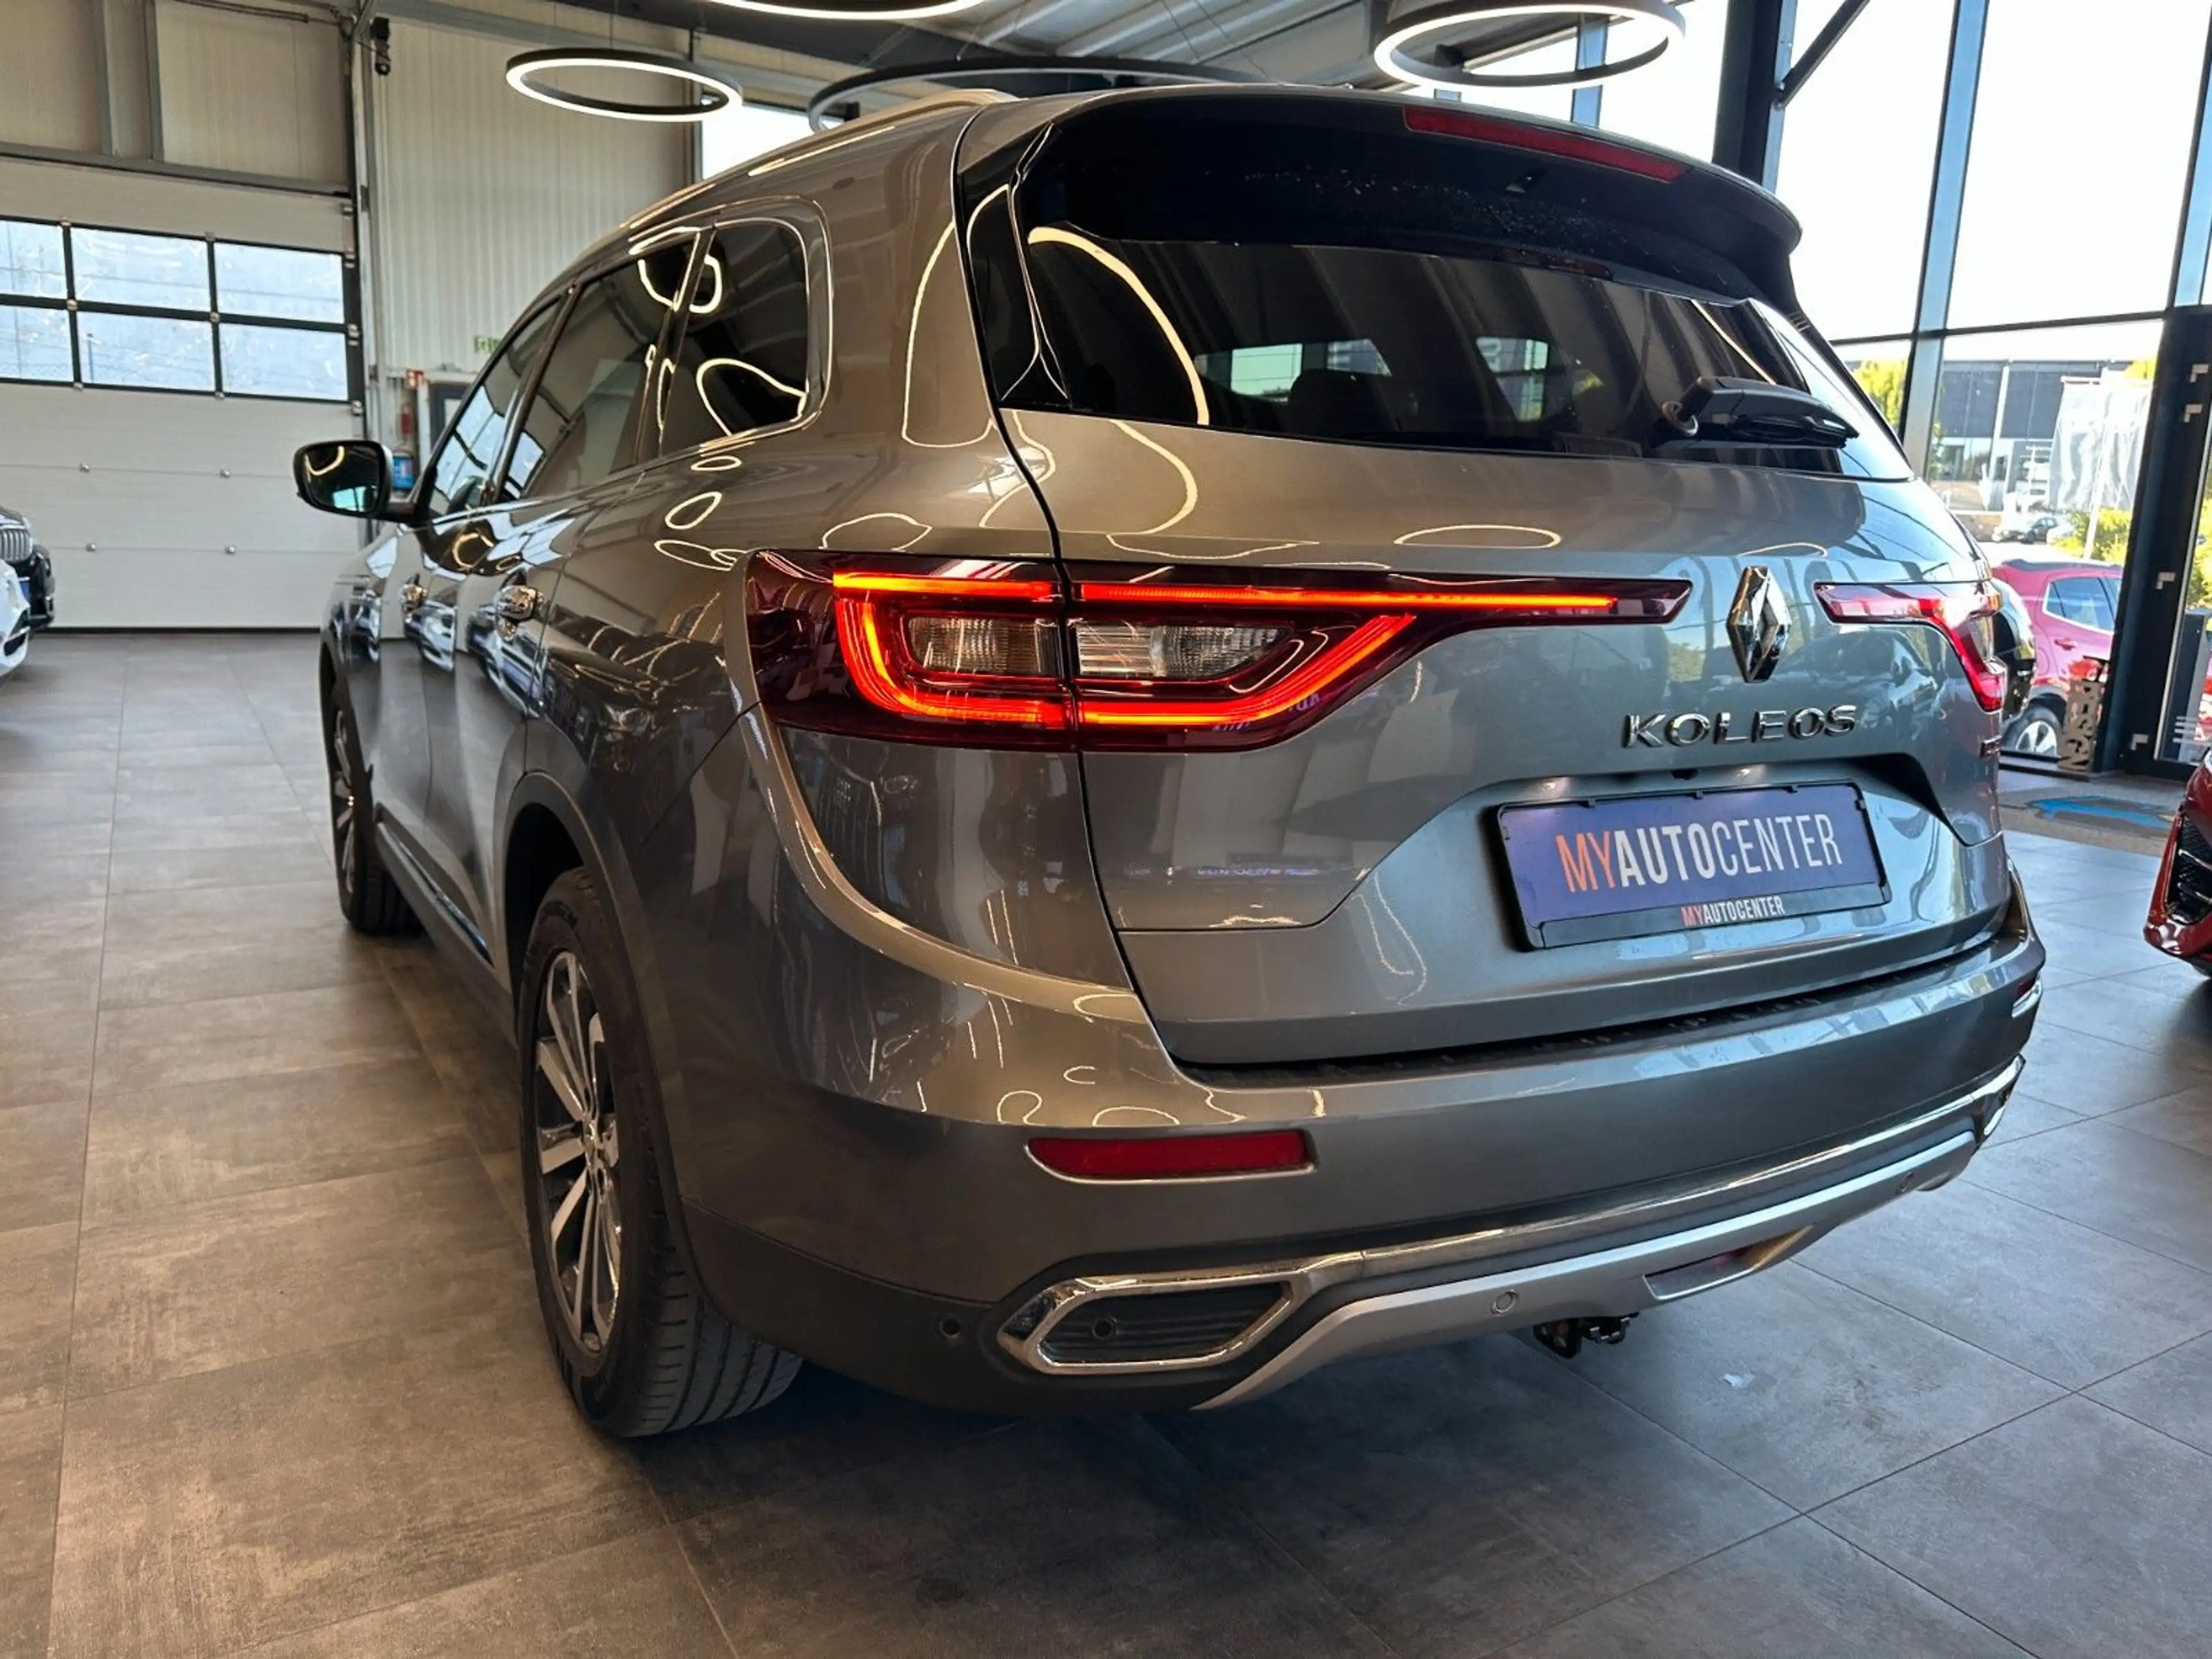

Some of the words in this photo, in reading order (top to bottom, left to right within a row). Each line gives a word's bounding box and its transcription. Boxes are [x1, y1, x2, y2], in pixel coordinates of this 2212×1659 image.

[1622, 704, 1857, 748] KOLEOS
[1556, 813, 1842, 892] MYAUTOCENTER
[1681, 896, 1785, 927] MYAUTOCENTER
